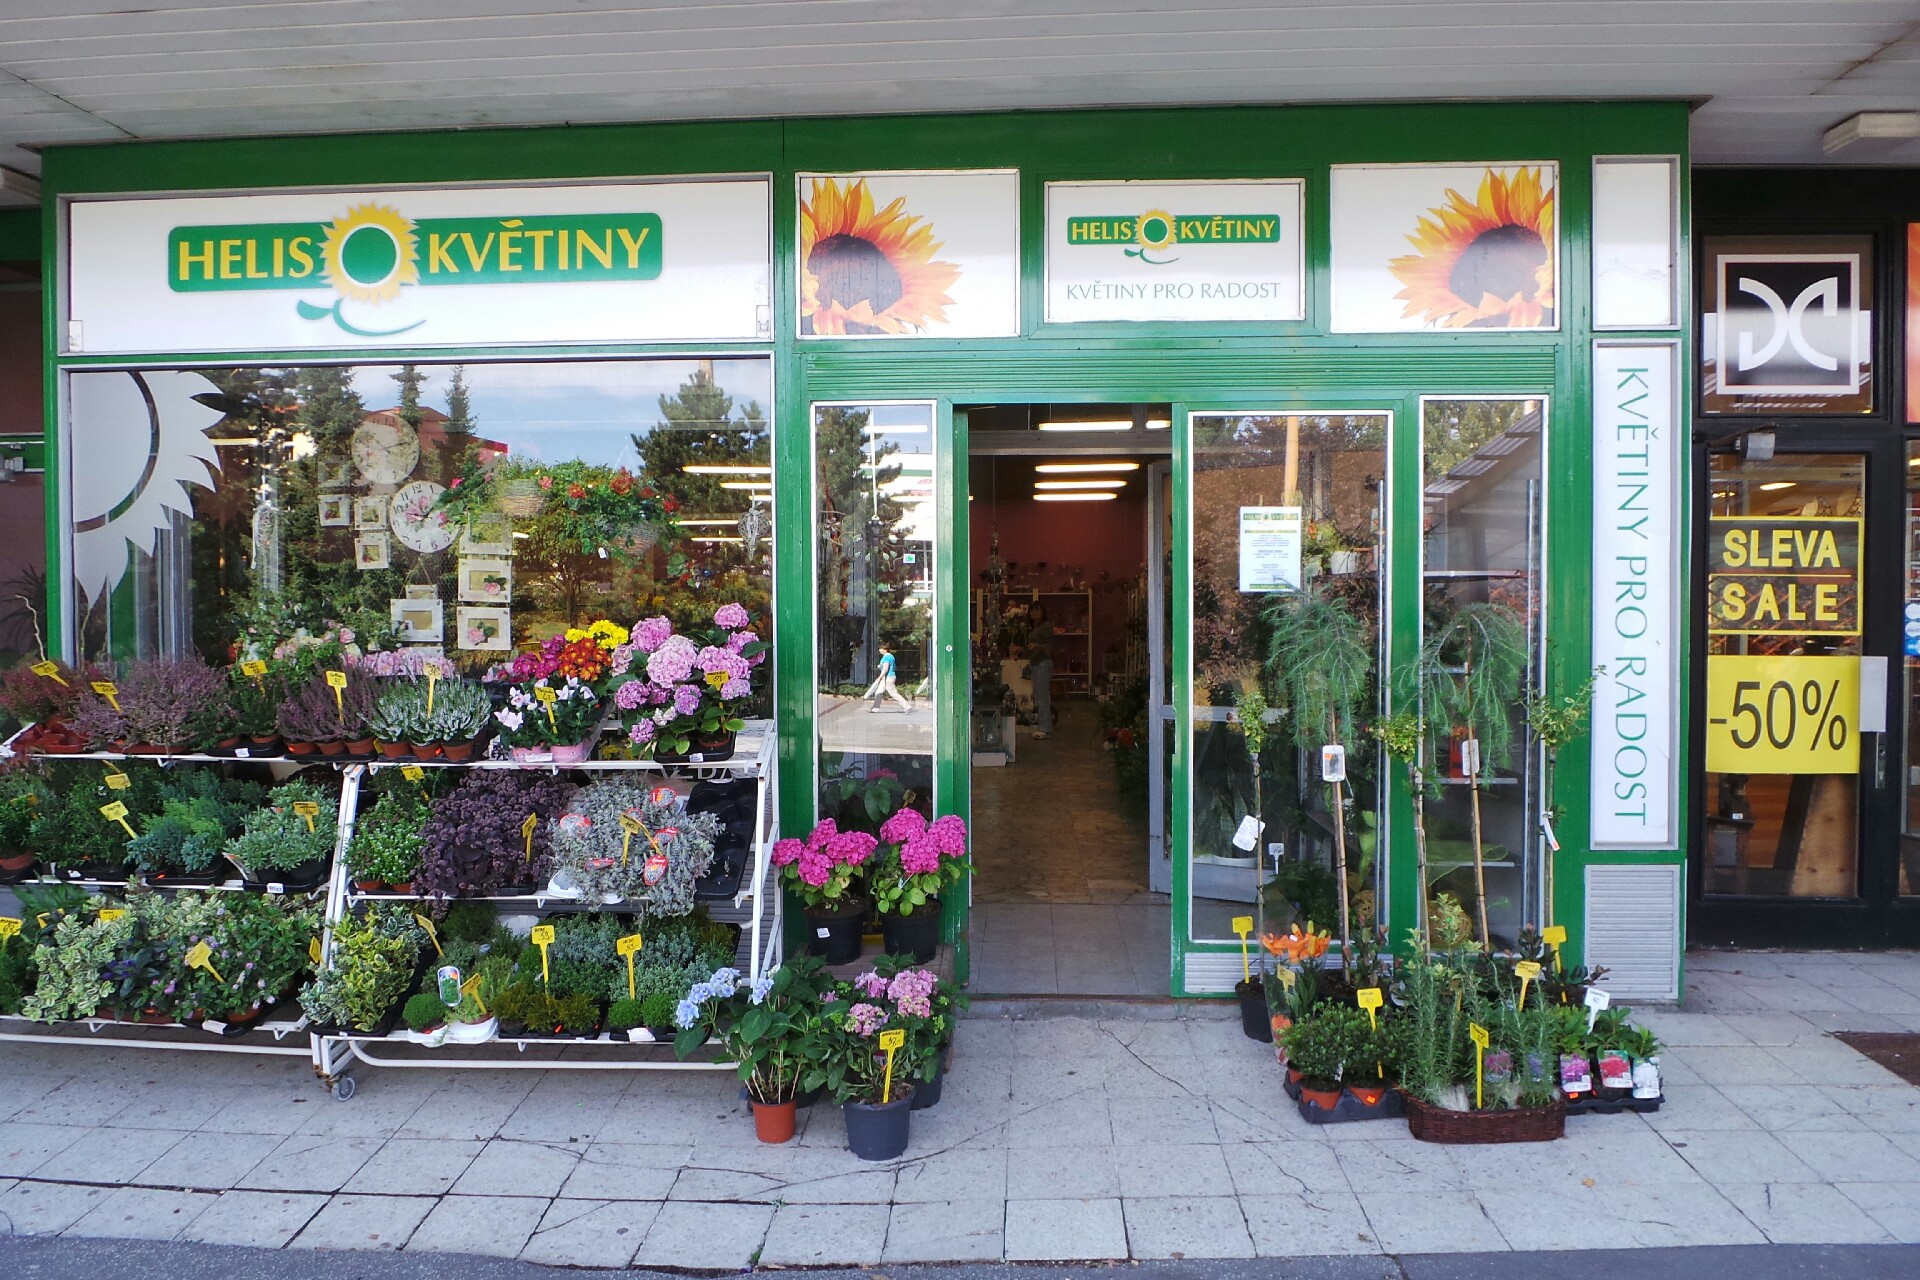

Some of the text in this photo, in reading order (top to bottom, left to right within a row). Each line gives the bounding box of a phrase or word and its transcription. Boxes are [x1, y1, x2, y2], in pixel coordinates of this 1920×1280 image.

[1072, 216, 1276, 241] HELIS KVĚTINY
[179, 219, 650, 281] HELIS KVĚTINY
[1066, 279, 1281, 300] KVĚTINY PRO RADOST
[1723, 529, 1840, 568] SLEVA
[1614, 368, 1659, 826] KVĚTINY PRO RADOST
[1722, 583, 1838, 621] SALE
[1709, 680, 1847, 751] -50%
